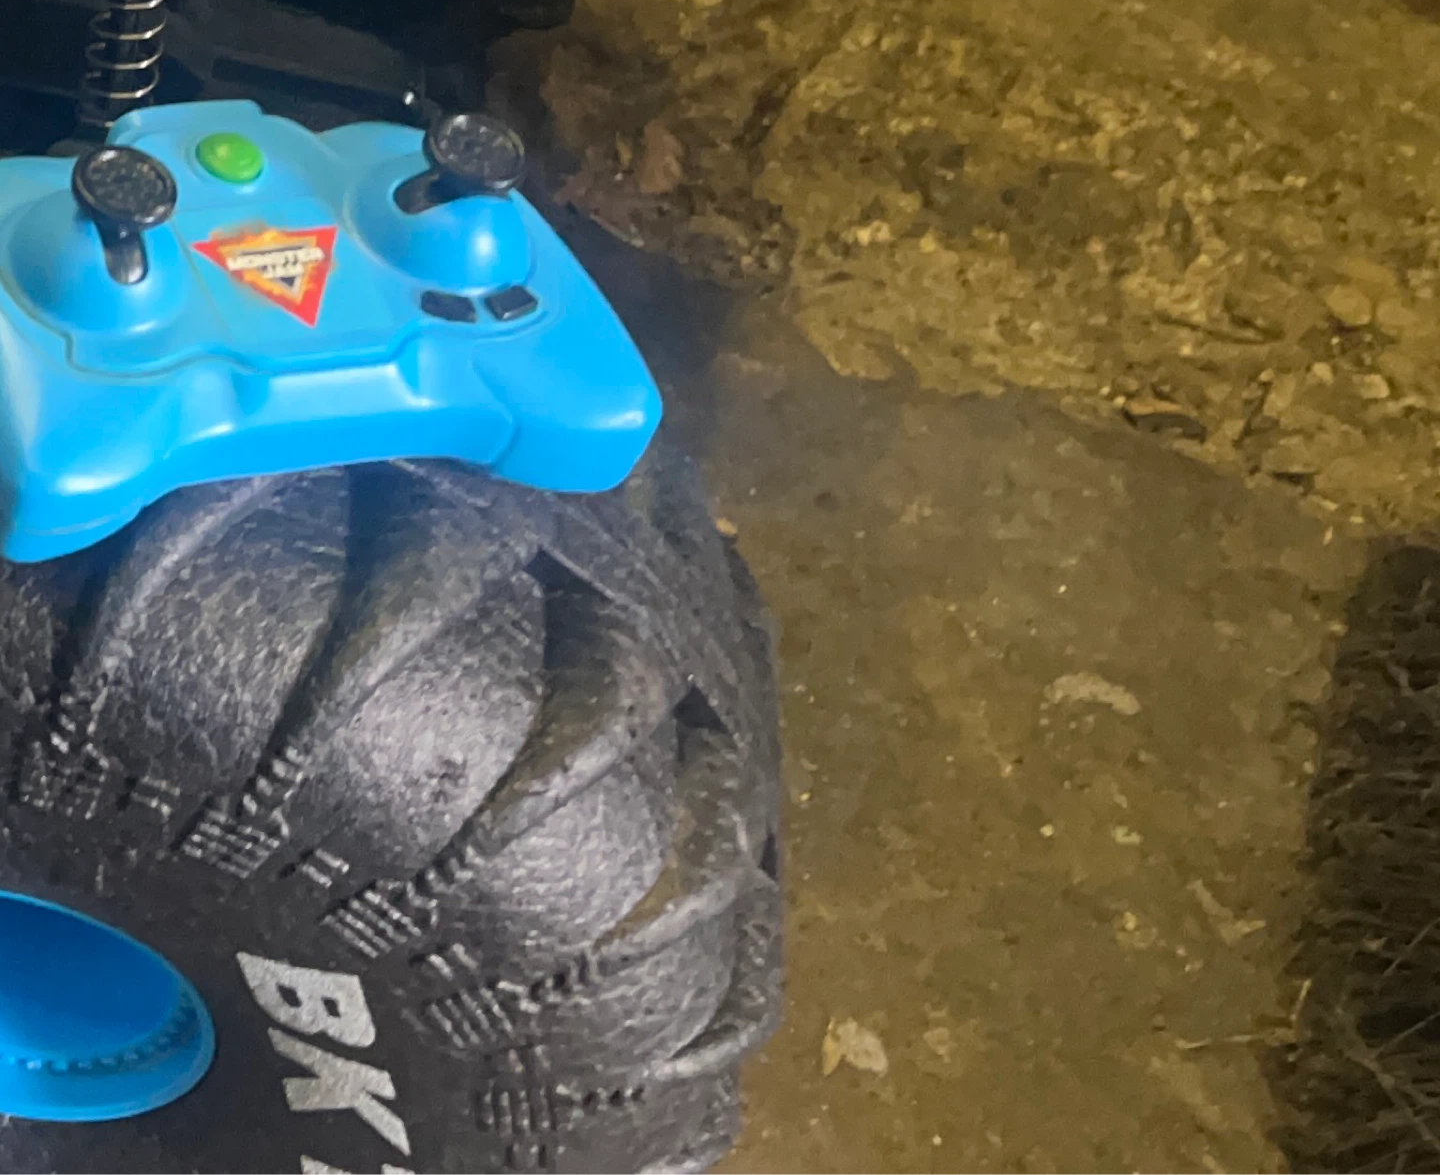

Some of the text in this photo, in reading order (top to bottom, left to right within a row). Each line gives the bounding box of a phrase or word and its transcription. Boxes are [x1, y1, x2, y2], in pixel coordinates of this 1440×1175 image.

[227, 246, 325, 271] MONSTER
[262, 263, 305, 279] JAM
[236, 951, 417, 1175] BK
